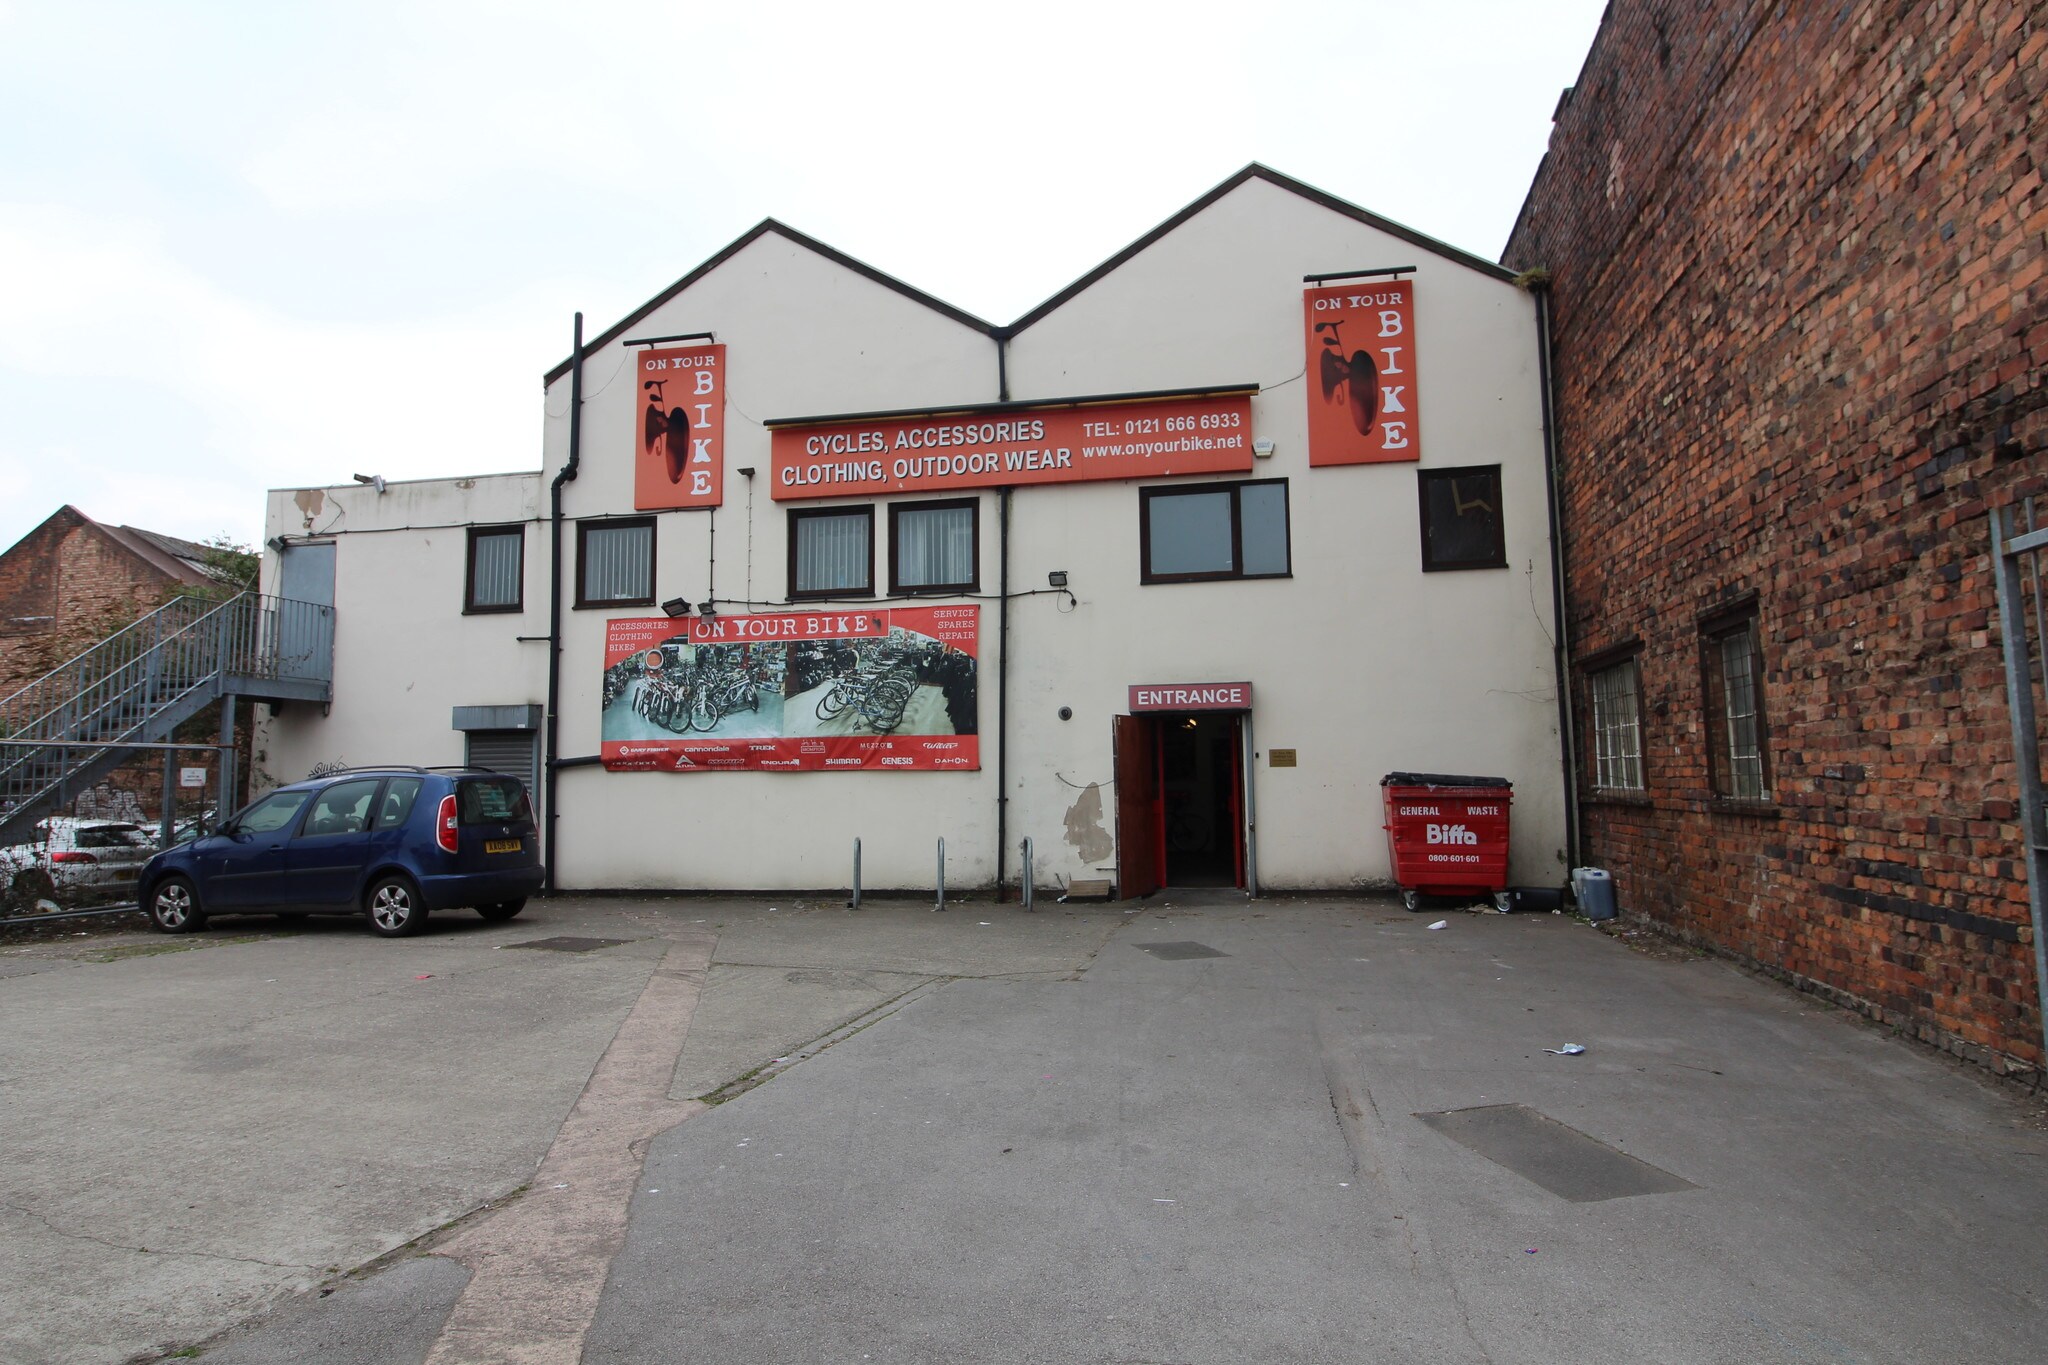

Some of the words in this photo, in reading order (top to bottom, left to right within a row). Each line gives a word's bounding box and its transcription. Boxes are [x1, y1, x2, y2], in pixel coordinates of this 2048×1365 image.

[1315, 298, 1341, 310] ON
[1347, 292, 1403, 308] YOUR
[646, 359, 667, 370] ON
[672, 356, 715, 369] YOUR
[1377, 310, 1408, 449] BIKE
[690, 370, 714, 496] BIKE
[1083, 423, 1120, 438] TEL:
[1125, 418, 1160, 434] 0121
[1166, 416, 1196, 432] 666
[1200, 412, 1240, 430] 6933
[806, 431, 889, 456] CYCLES,
[894, 420, 1045, 450] ACCESSORIES
[1082, 434, 1243, 458] www.onyourbike.net
[781, 460, 888, 486] CLOTHING,
[893, 453, 999, 479] OUTDOOR
[1004, 446, 1072, 472] WEAR
[934, 610, 974, 618] SERVICE
[610, 622, 669, 631] ACCESSORIES
[696, 620, 726, 638] ON
[732, 617, 798, 636] YOUR
[806, 615, 868, 634] BIKE
[938, 620, 974, 628] SPARES
[610, 632, 652, 641] CLOTHING
[938, 632, 974, 640] REPAIR
[609, 644, 636, 652] BIKES
[1138, 688, 1242, 705] ENTRANCE
[1400, 806, 1440, 816] GENERAL
[1467, 806, 1498, 816] WASTE
[1426, 824, 1477, 844] Biffa
